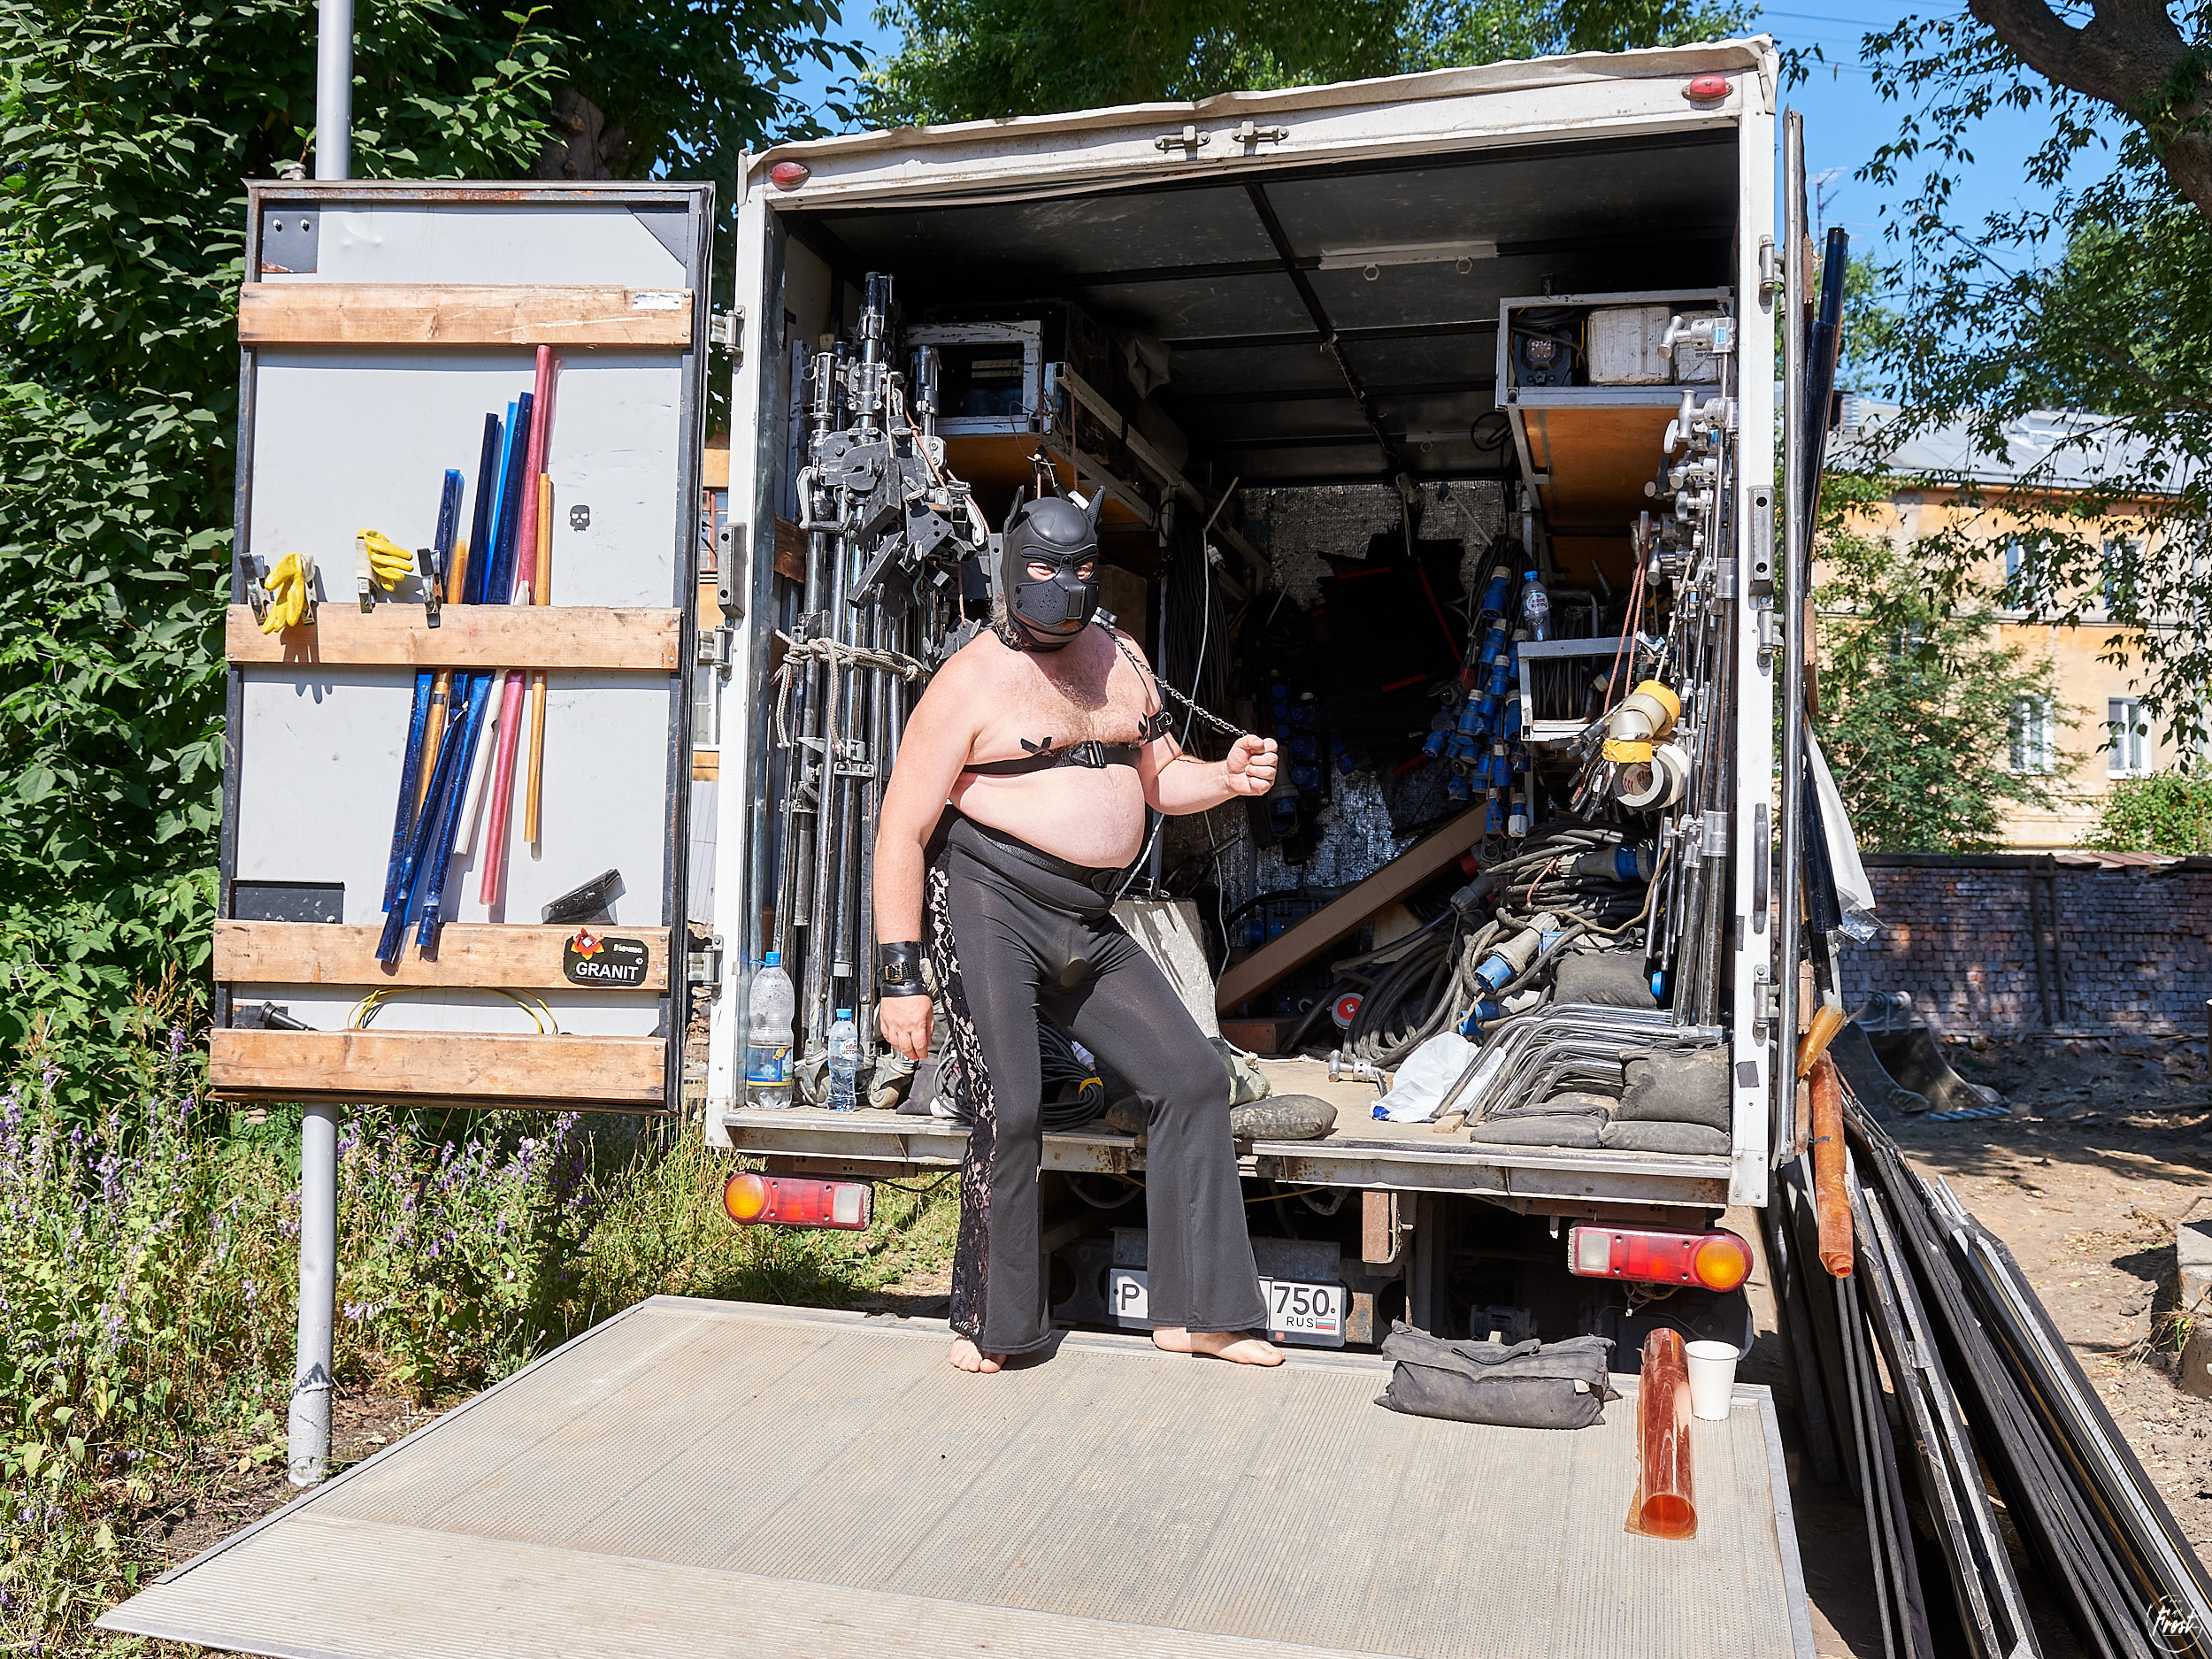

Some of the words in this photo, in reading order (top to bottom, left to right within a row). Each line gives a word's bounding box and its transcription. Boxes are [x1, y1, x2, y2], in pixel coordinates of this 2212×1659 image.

[576, 961, 639, 980] GRANIT
[1274, 1286, 1330, 1317] 750
[1286, 1316, 1314, 1328] RUS
